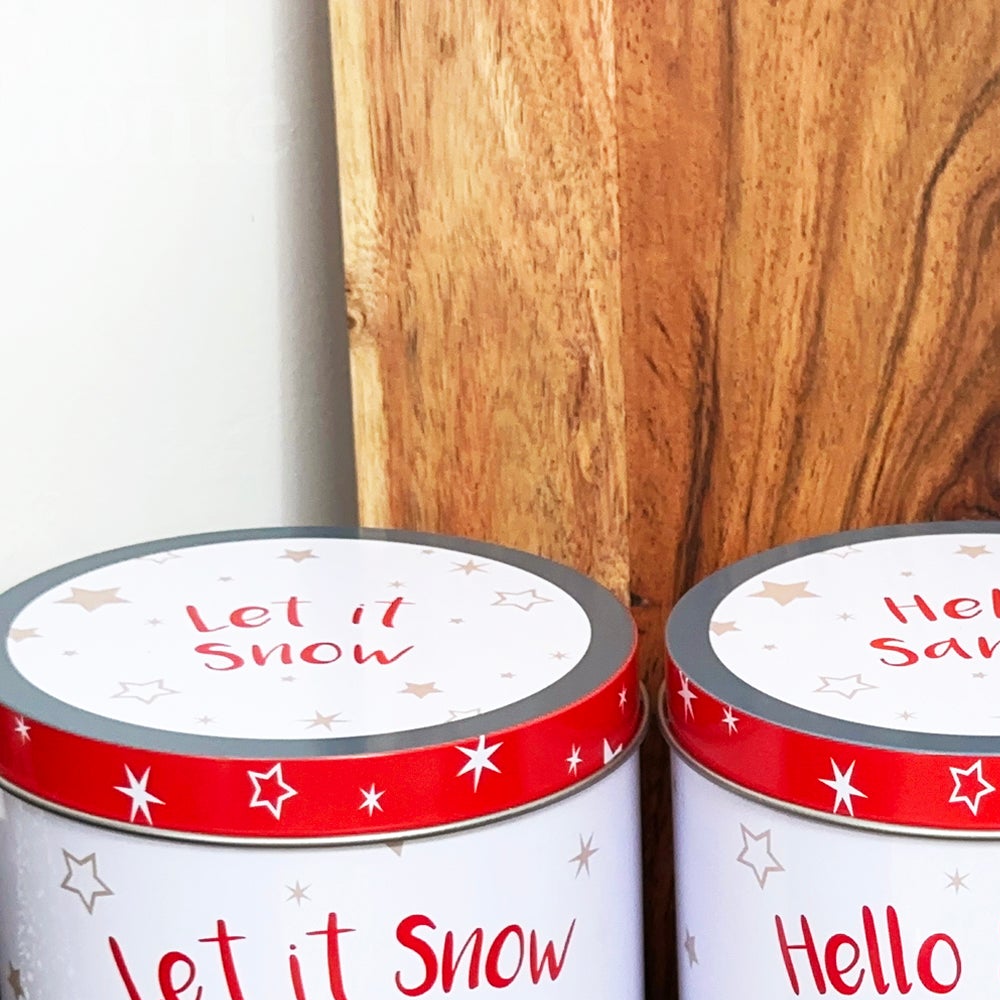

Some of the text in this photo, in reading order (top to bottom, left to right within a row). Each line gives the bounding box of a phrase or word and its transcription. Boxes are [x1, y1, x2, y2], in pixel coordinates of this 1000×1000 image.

[185, 596, 416, 633] Let it
[394, 913, 577, 998] Snow
[774, 904, 963, 997] Hello
